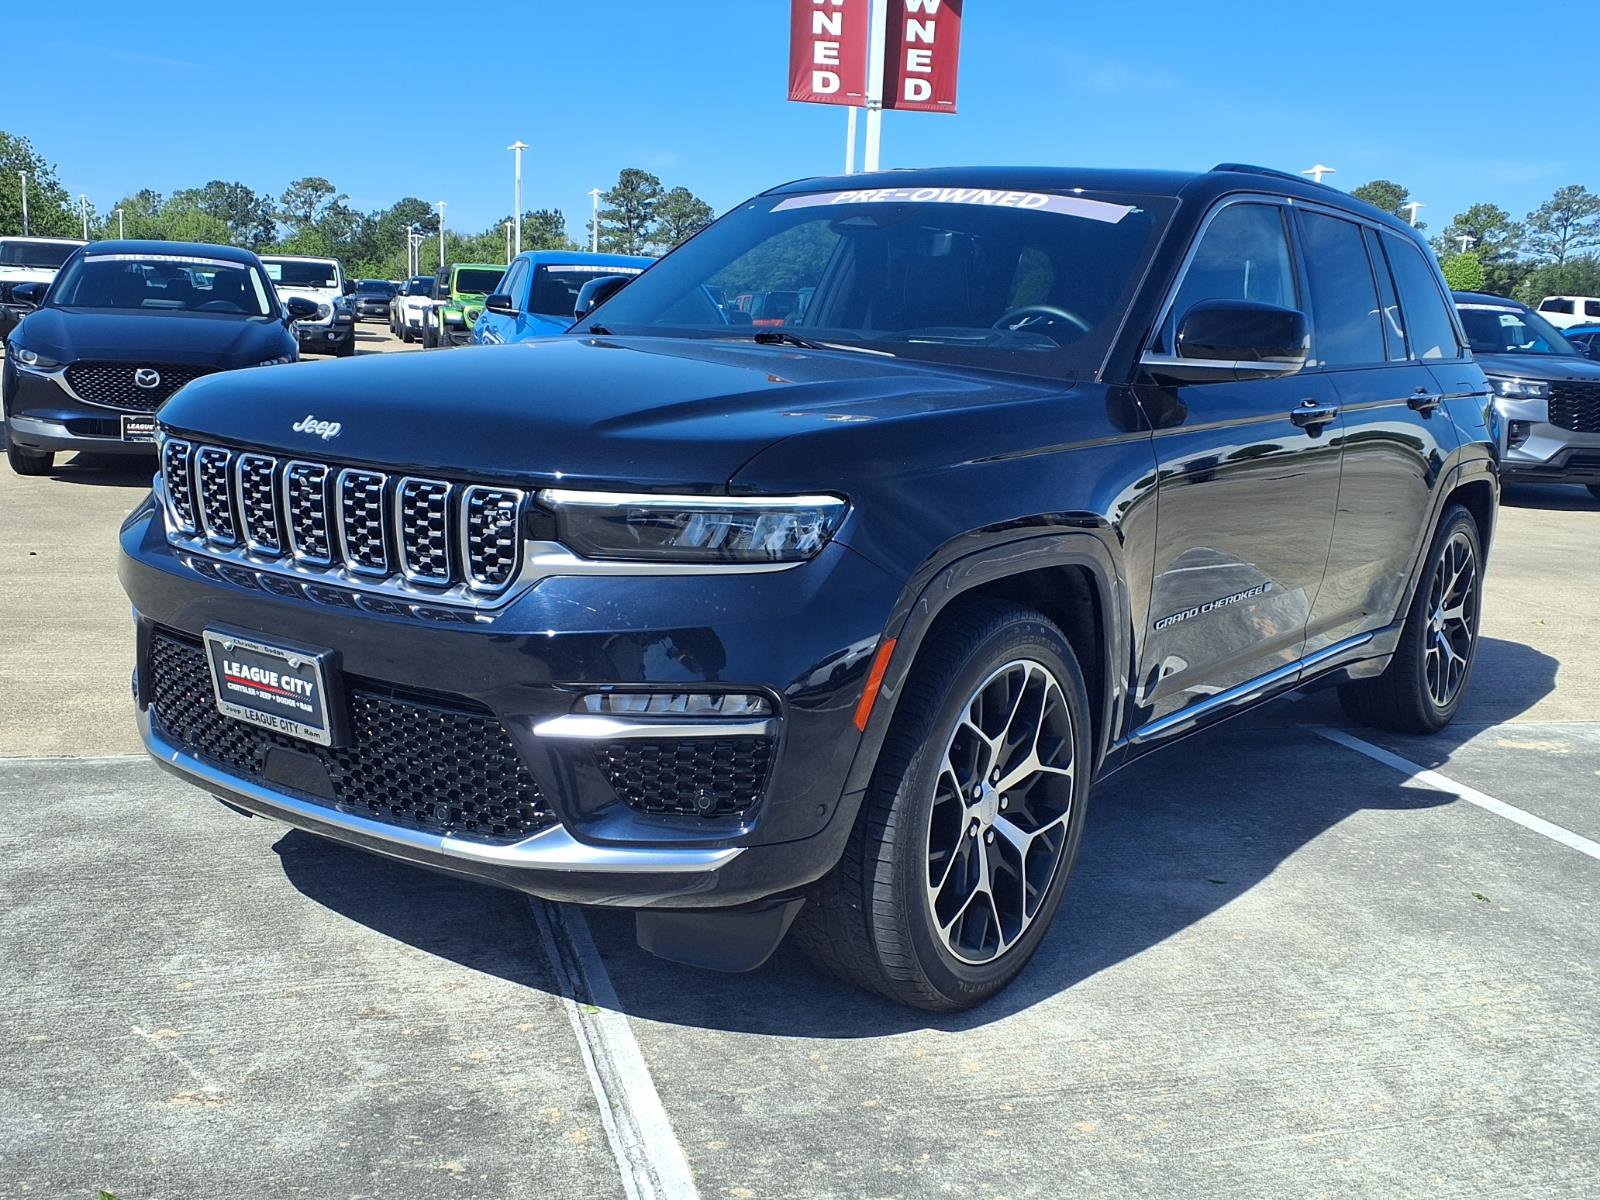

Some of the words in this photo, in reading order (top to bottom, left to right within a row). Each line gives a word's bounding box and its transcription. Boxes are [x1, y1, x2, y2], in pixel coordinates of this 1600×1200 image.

[811, 0, 843, 94] NED
[830, 187, 1049, 209] PRE-OWNED
[115, 253, 213, 265] PRE-OWNED
[292, 414, 342, 440] Jeep
[1155, 607, 1199, 630] GRAND
[1200, 585, 1264, 615] CHEROKEE
[223, 660, 279, 687] LEAGUE
[280, 675, 313, 697] CITY
[244, 708, 278, 728] LEAGUE
[280, 719, 299, 734] CITY
[303, 728, 321, 739] Ram
